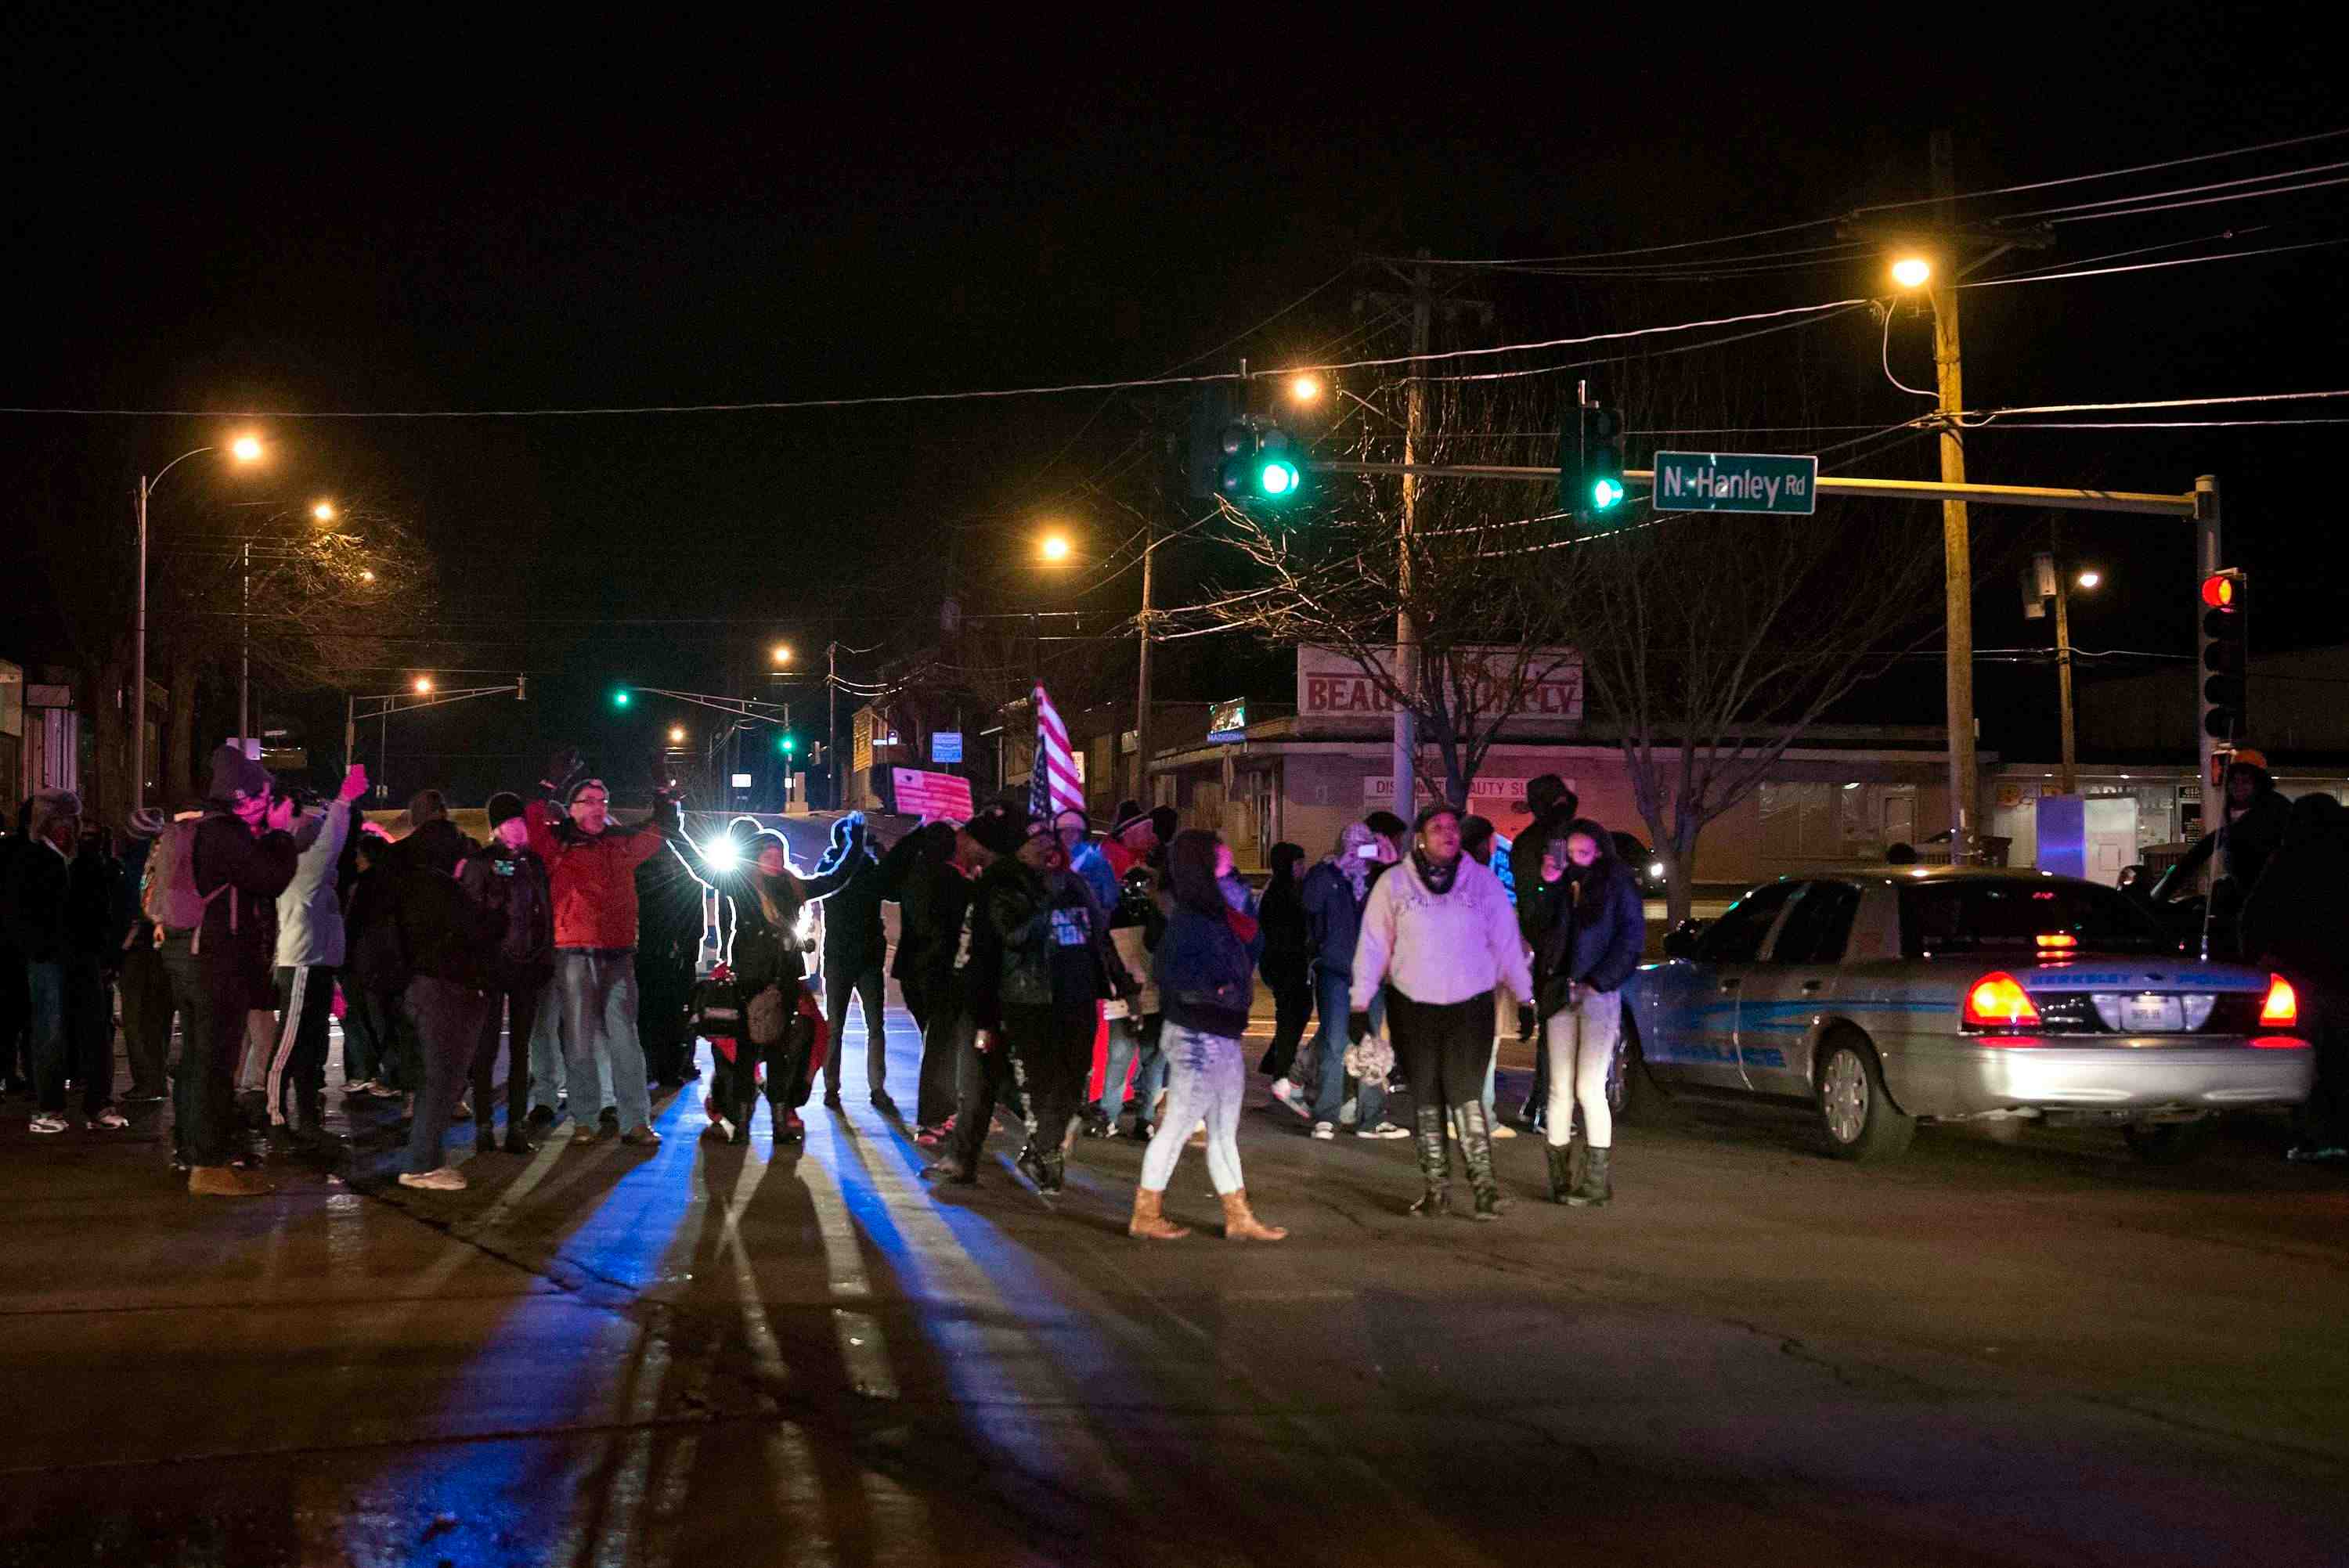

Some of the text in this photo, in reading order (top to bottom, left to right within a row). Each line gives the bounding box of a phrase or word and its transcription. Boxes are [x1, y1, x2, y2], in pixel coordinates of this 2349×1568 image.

[1663, 465, 1806, 509] N. Hanley Rd
[1308, 678, 1395, 711] BEAU
[1469, 781, 1504, 795] AUTY
